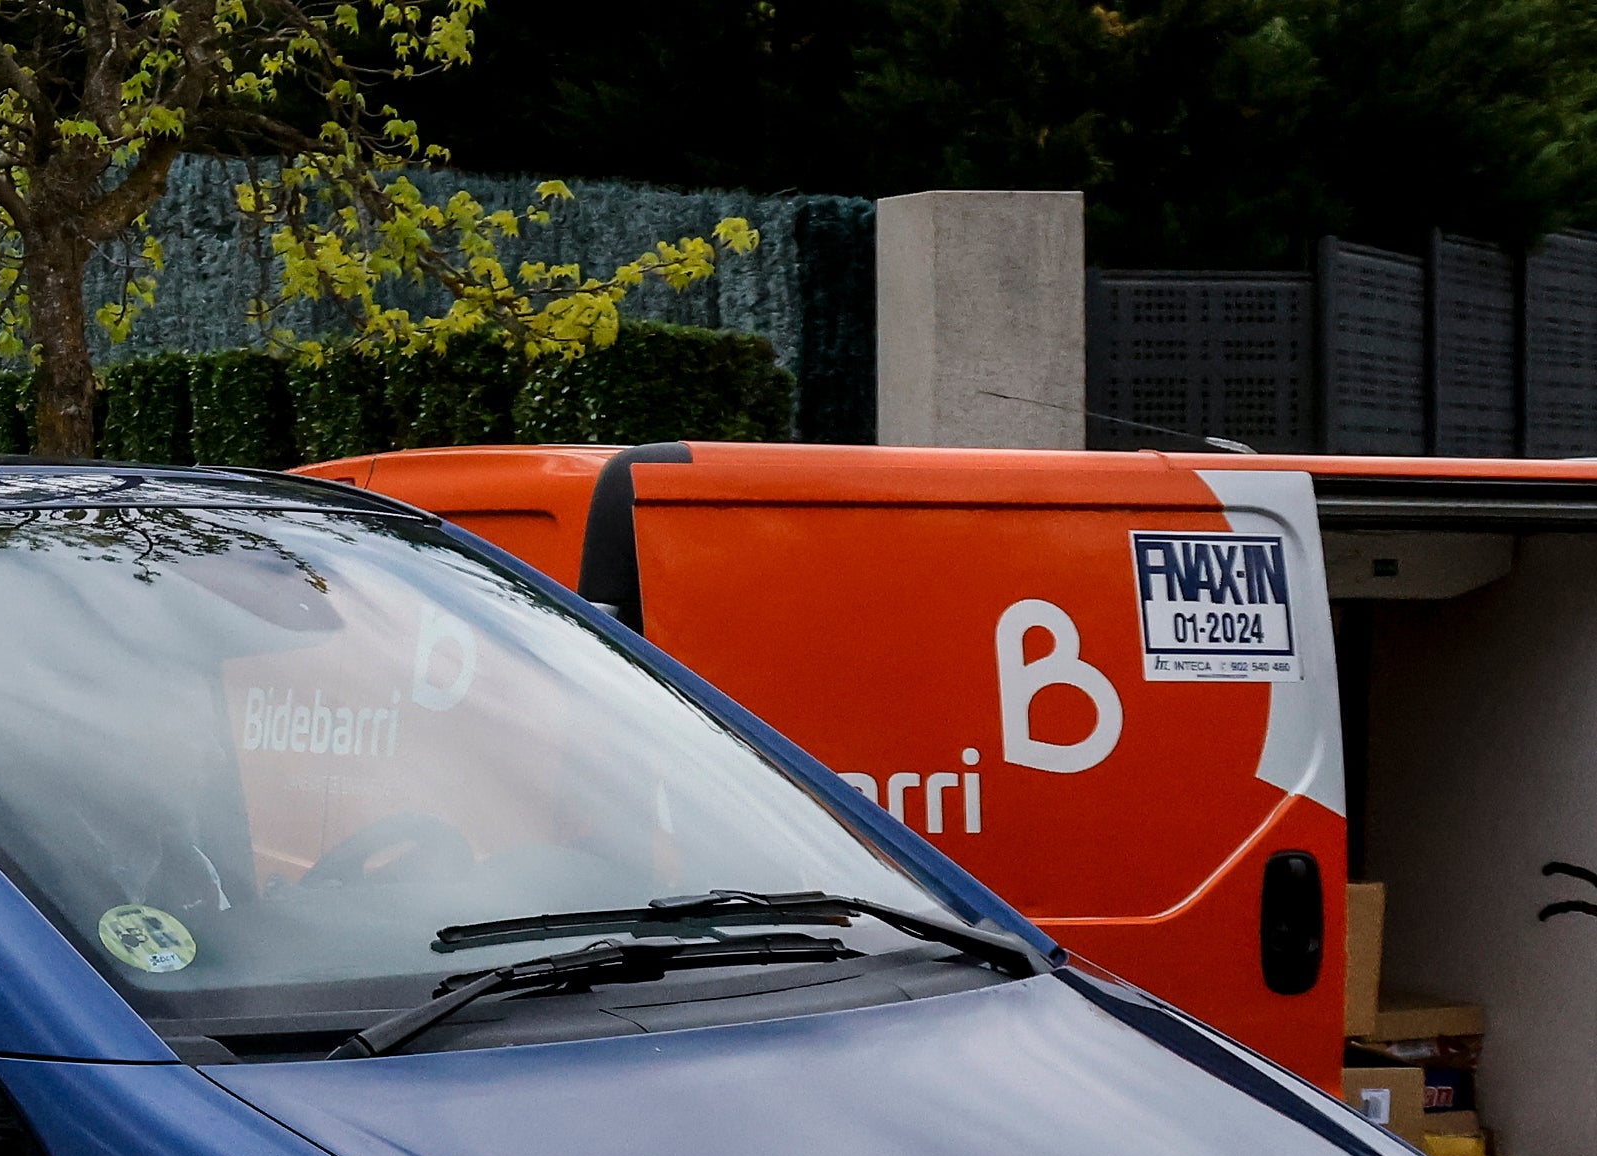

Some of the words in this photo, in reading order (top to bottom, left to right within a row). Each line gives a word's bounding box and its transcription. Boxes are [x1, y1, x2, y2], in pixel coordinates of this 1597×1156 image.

[1173, 612, 1265, 644] 01-2024
[995, 599, 1124, 774] B
[243, 687, 401, 757] Bidebarri
